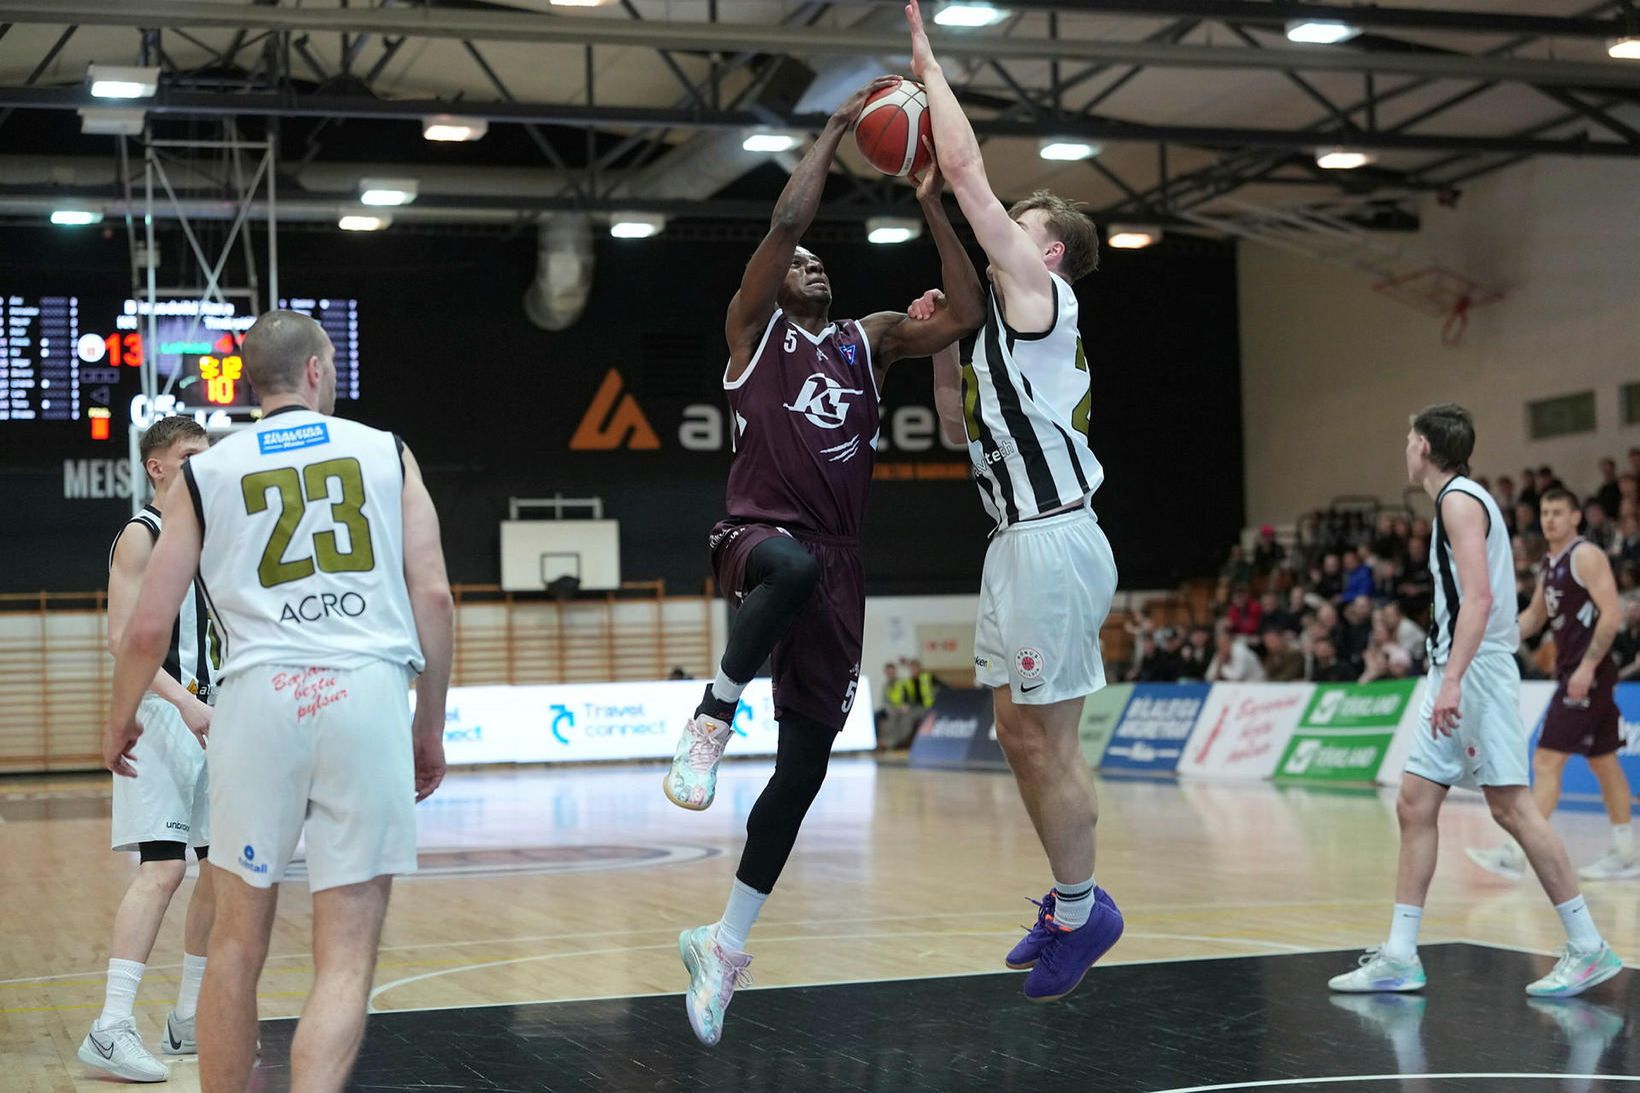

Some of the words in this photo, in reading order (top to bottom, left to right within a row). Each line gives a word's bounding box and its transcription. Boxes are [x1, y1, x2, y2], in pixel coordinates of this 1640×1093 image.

[784, 329, 798, 353] 5
[64, 458, 131, 499] MEIS
[241, 456, 375, 589] 23
[280, 592, 366, 623] ACRO
[584, 702, 644, 718] Travel
[841, 681, 857, 713] 5
[584, 720, 666, 737] connect
